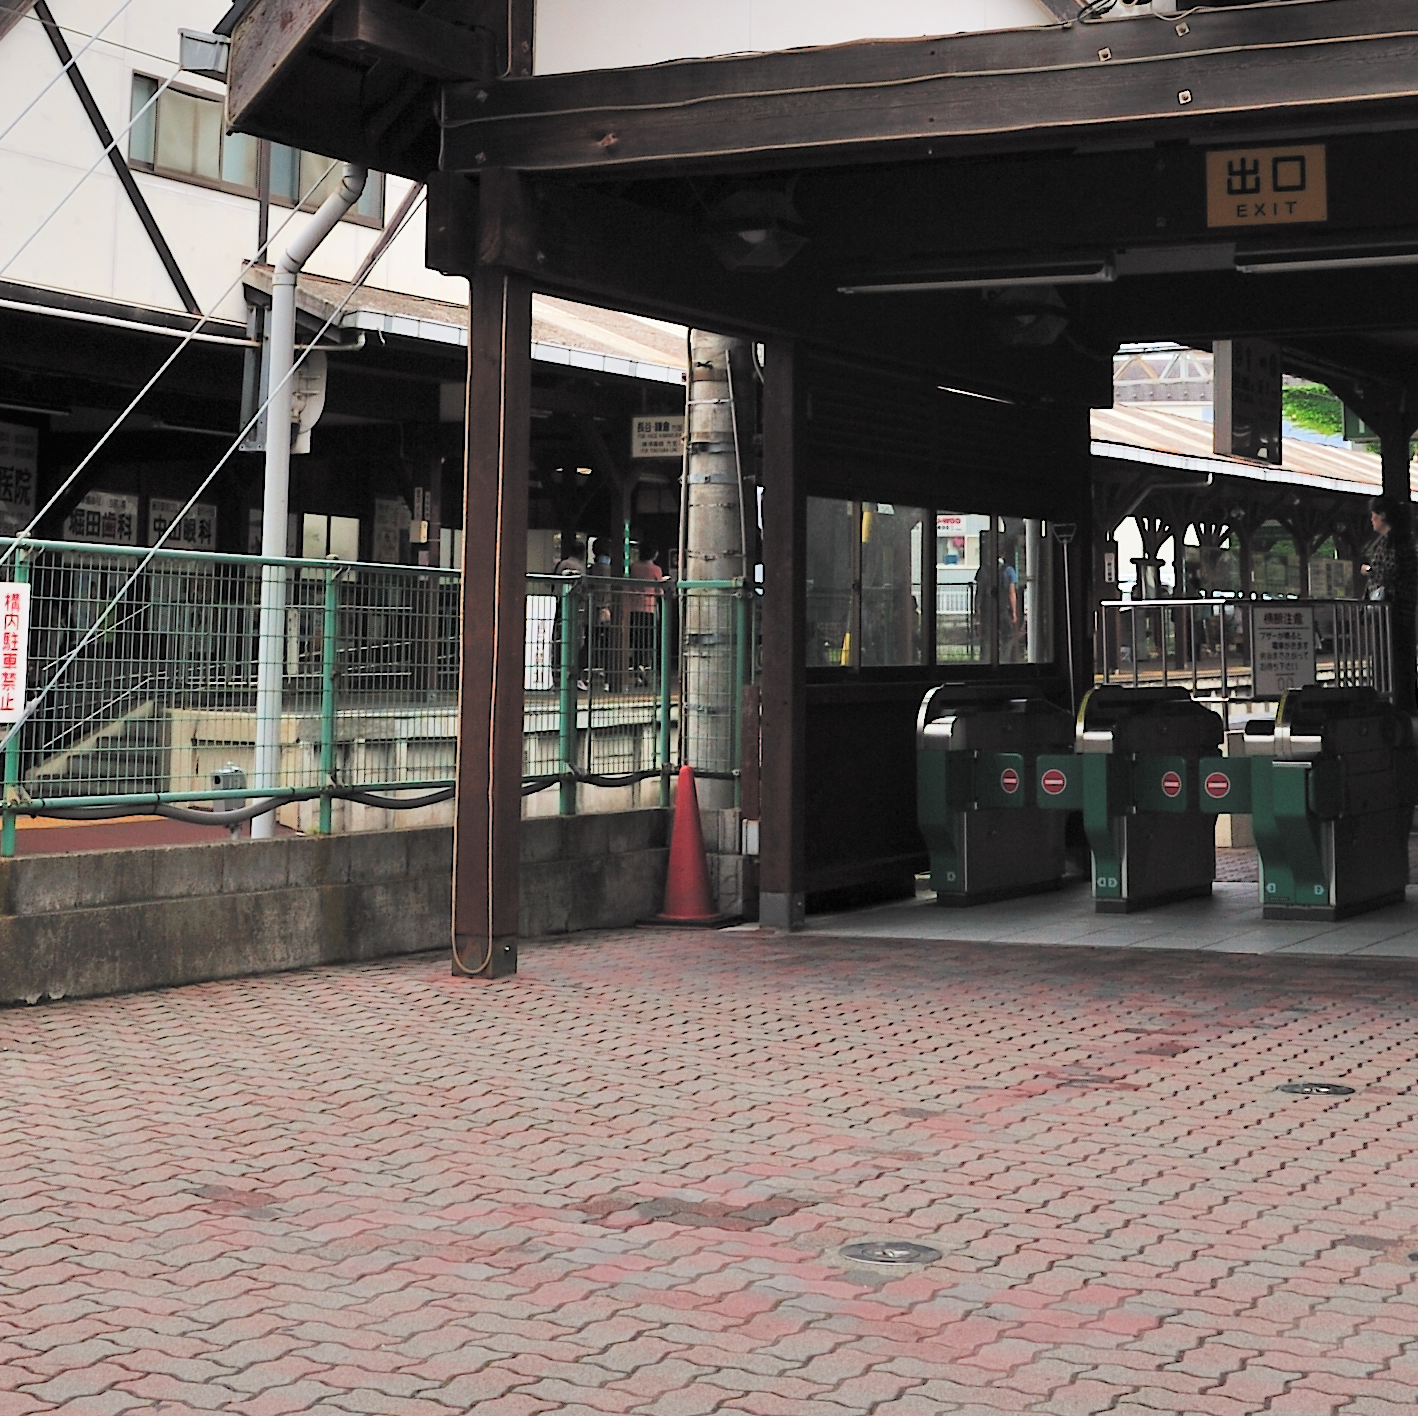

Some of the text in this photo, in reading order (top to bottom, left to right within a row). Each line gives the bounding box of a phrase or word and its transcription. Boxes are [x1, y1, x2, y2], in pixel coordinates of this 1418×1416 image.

[1227, 155, 1306, 195] 出口
[1237, 201, 1297, 217] EXIT
[0, 593, 21, 711] 構内駐車禁止
